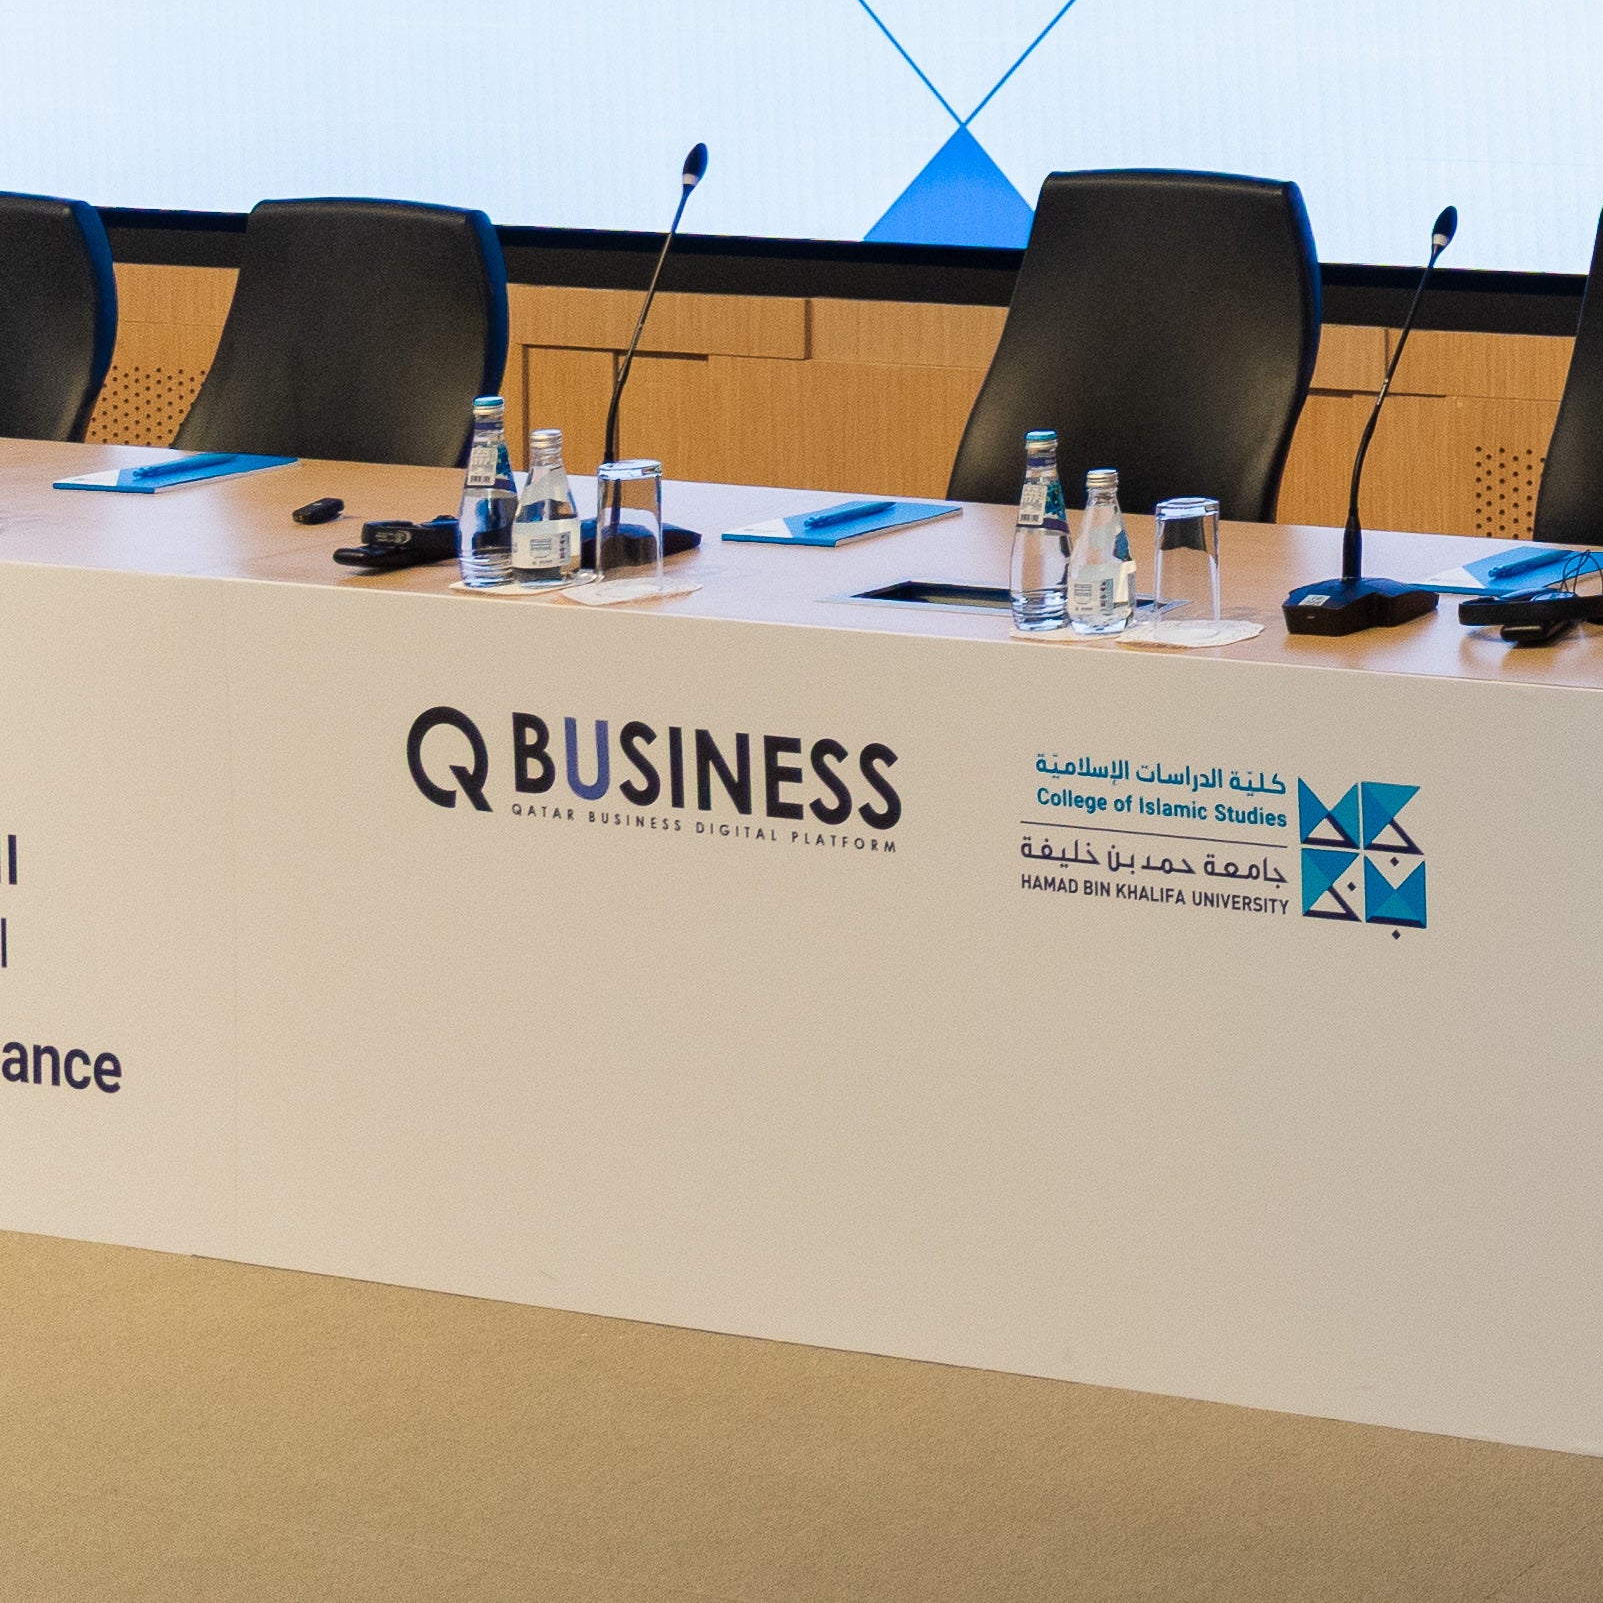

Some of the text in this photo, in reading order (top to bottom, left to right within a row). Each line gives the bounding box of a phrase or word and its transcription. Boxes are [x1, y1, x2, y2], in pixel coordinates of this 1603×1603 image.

[406, 706, 902, 830] Q BUSINESS
[1136, 763, 1223, 792] الدراسات
[512, 804, 896, 852] QATAR BUSINESS DIGITAL PLATFORM
[1037, 787, 1287, 827] College of Islamic Studies
[1021, 836, 1288, 889] جامعة حمد بن خليفة
[1022, 874, 1289, 915] HAMAD BIN KHALIFA UNIVERSITY
